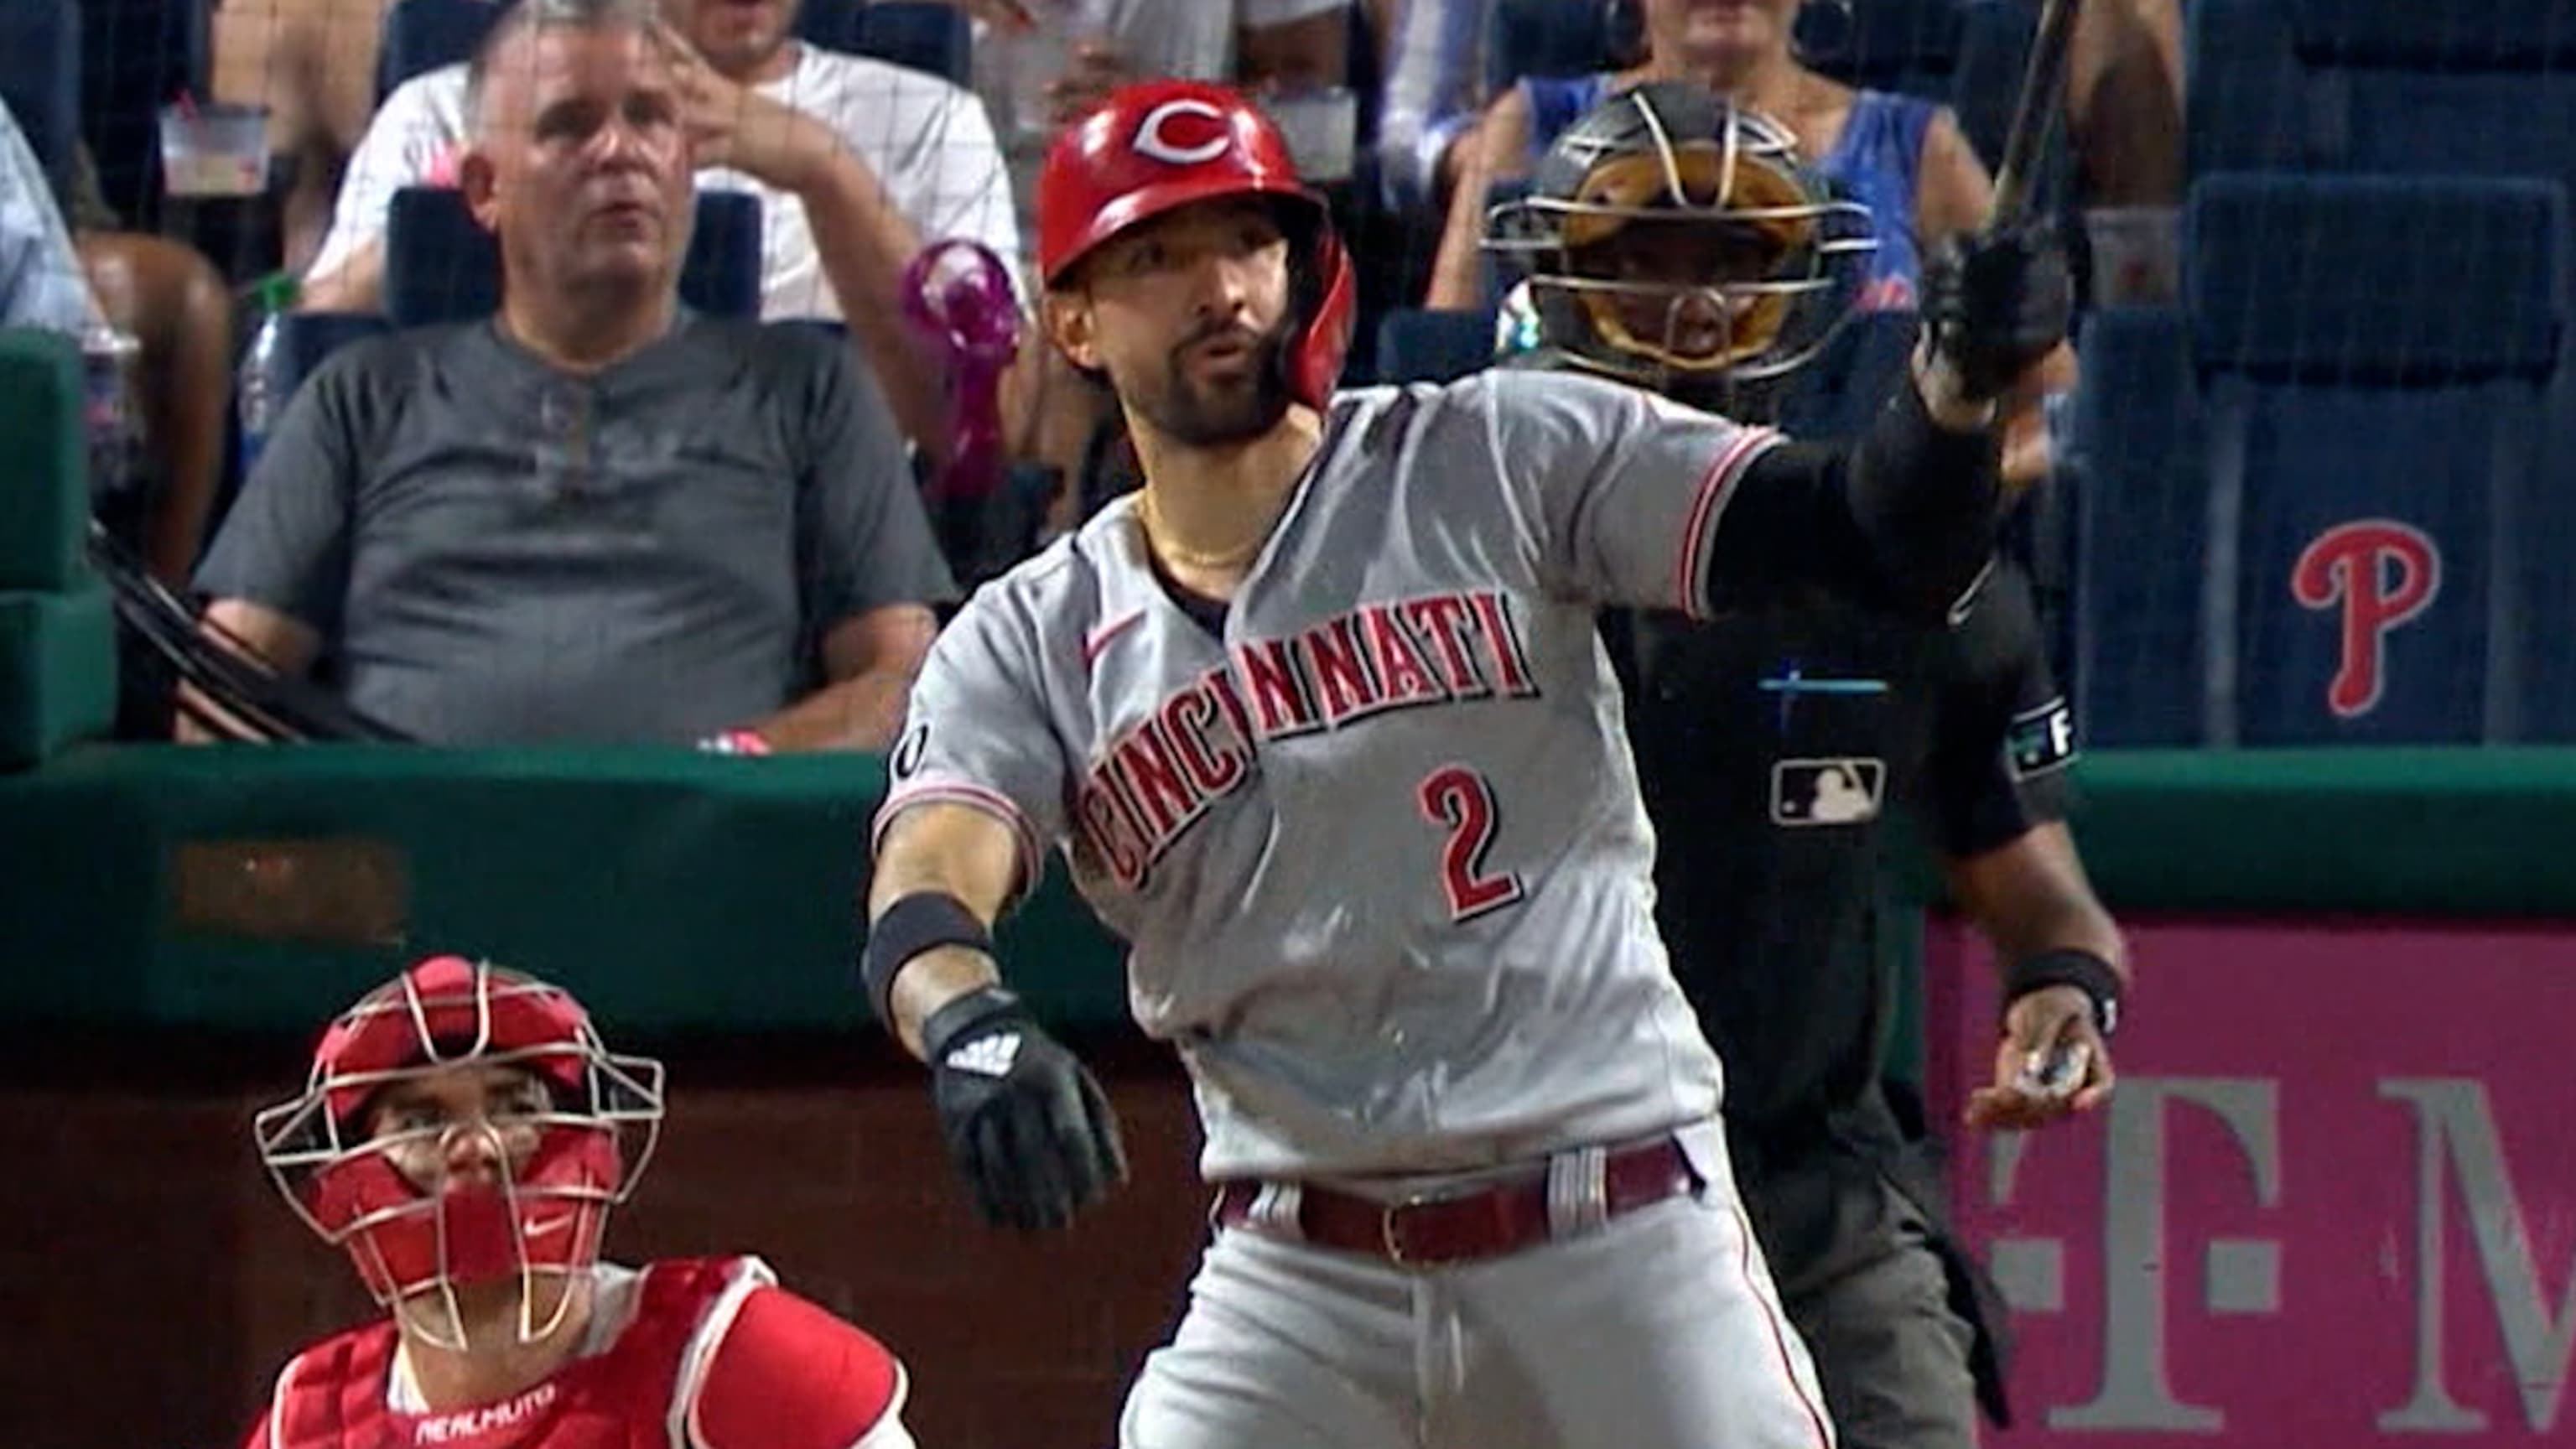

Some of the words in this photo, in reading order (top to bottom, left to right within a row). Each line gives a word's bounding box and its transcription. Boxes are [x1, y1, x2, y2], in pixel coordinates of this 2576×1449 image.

[1133, 97, 1231, 164] C
[2291, 518, 2442, 717] P
[1080, 589, 1541, 891] CINCINNATI
[1417, 761, 1524, 922] 2
[416, 1383, 556, 1445] REALMUTO
